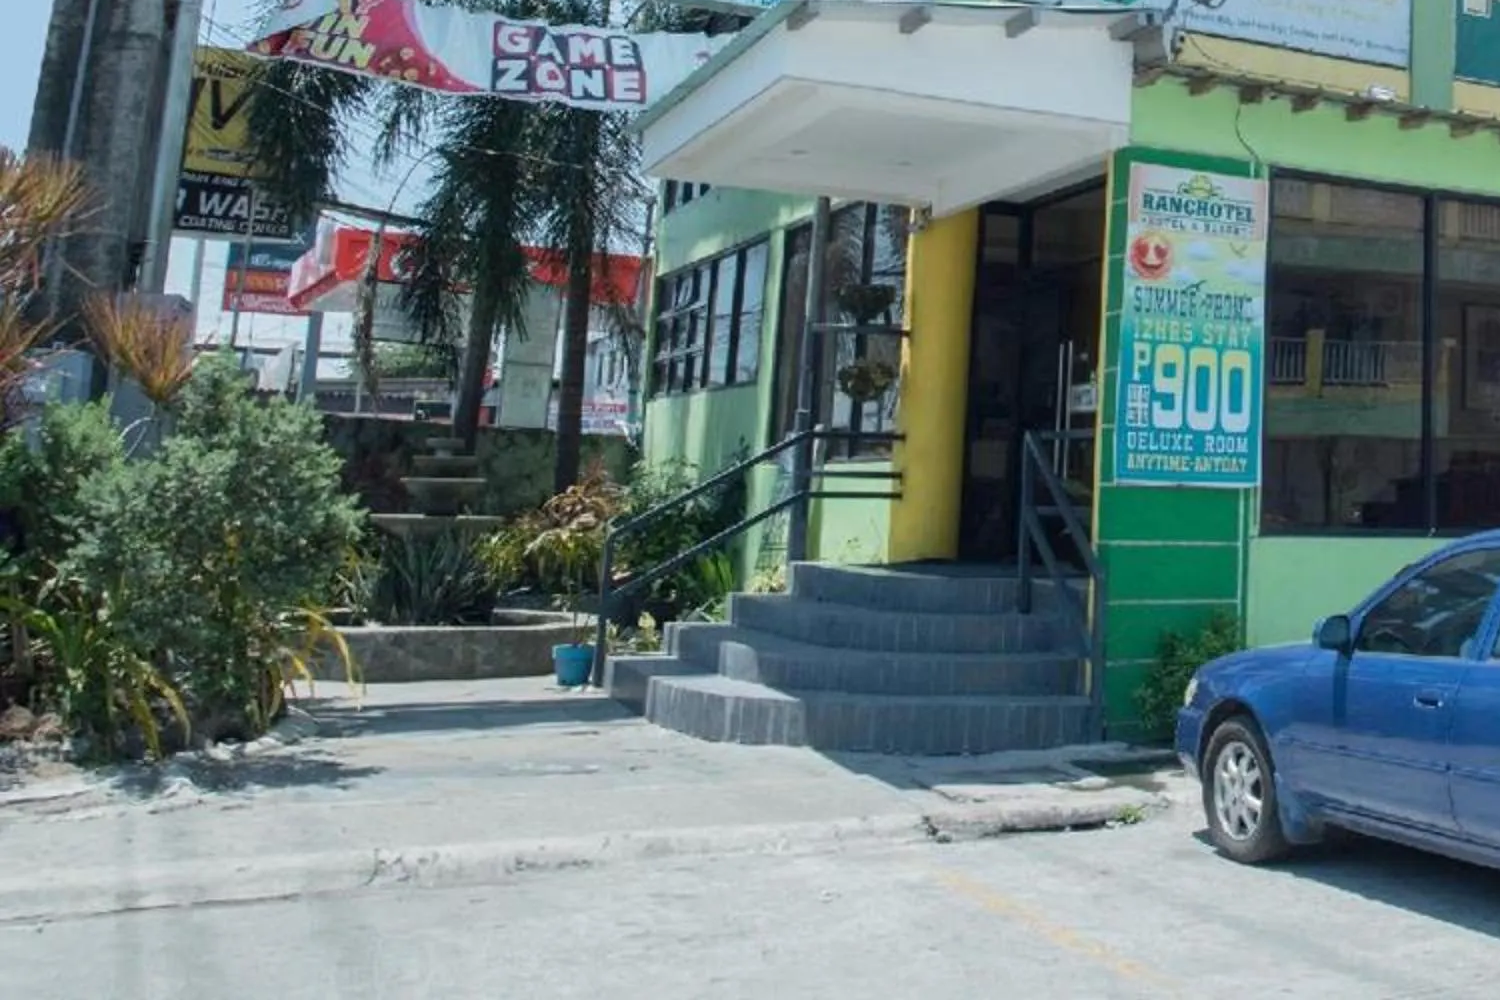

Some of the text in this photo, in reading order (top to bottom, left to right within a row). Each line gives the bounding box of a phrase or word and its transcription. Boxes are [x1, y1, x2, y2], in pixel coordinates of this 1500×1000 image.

[497, 25, 638, 67] GAME
[495, 59, 642, 101] ZONE
[1142, 192, 1257, 224] RANCHOTEL
[1202, 321, 1251, 348] STAY
[1151, 343, 1251, 434] 900
[1127, 431, 1249, 454] DELUXE ROOM
